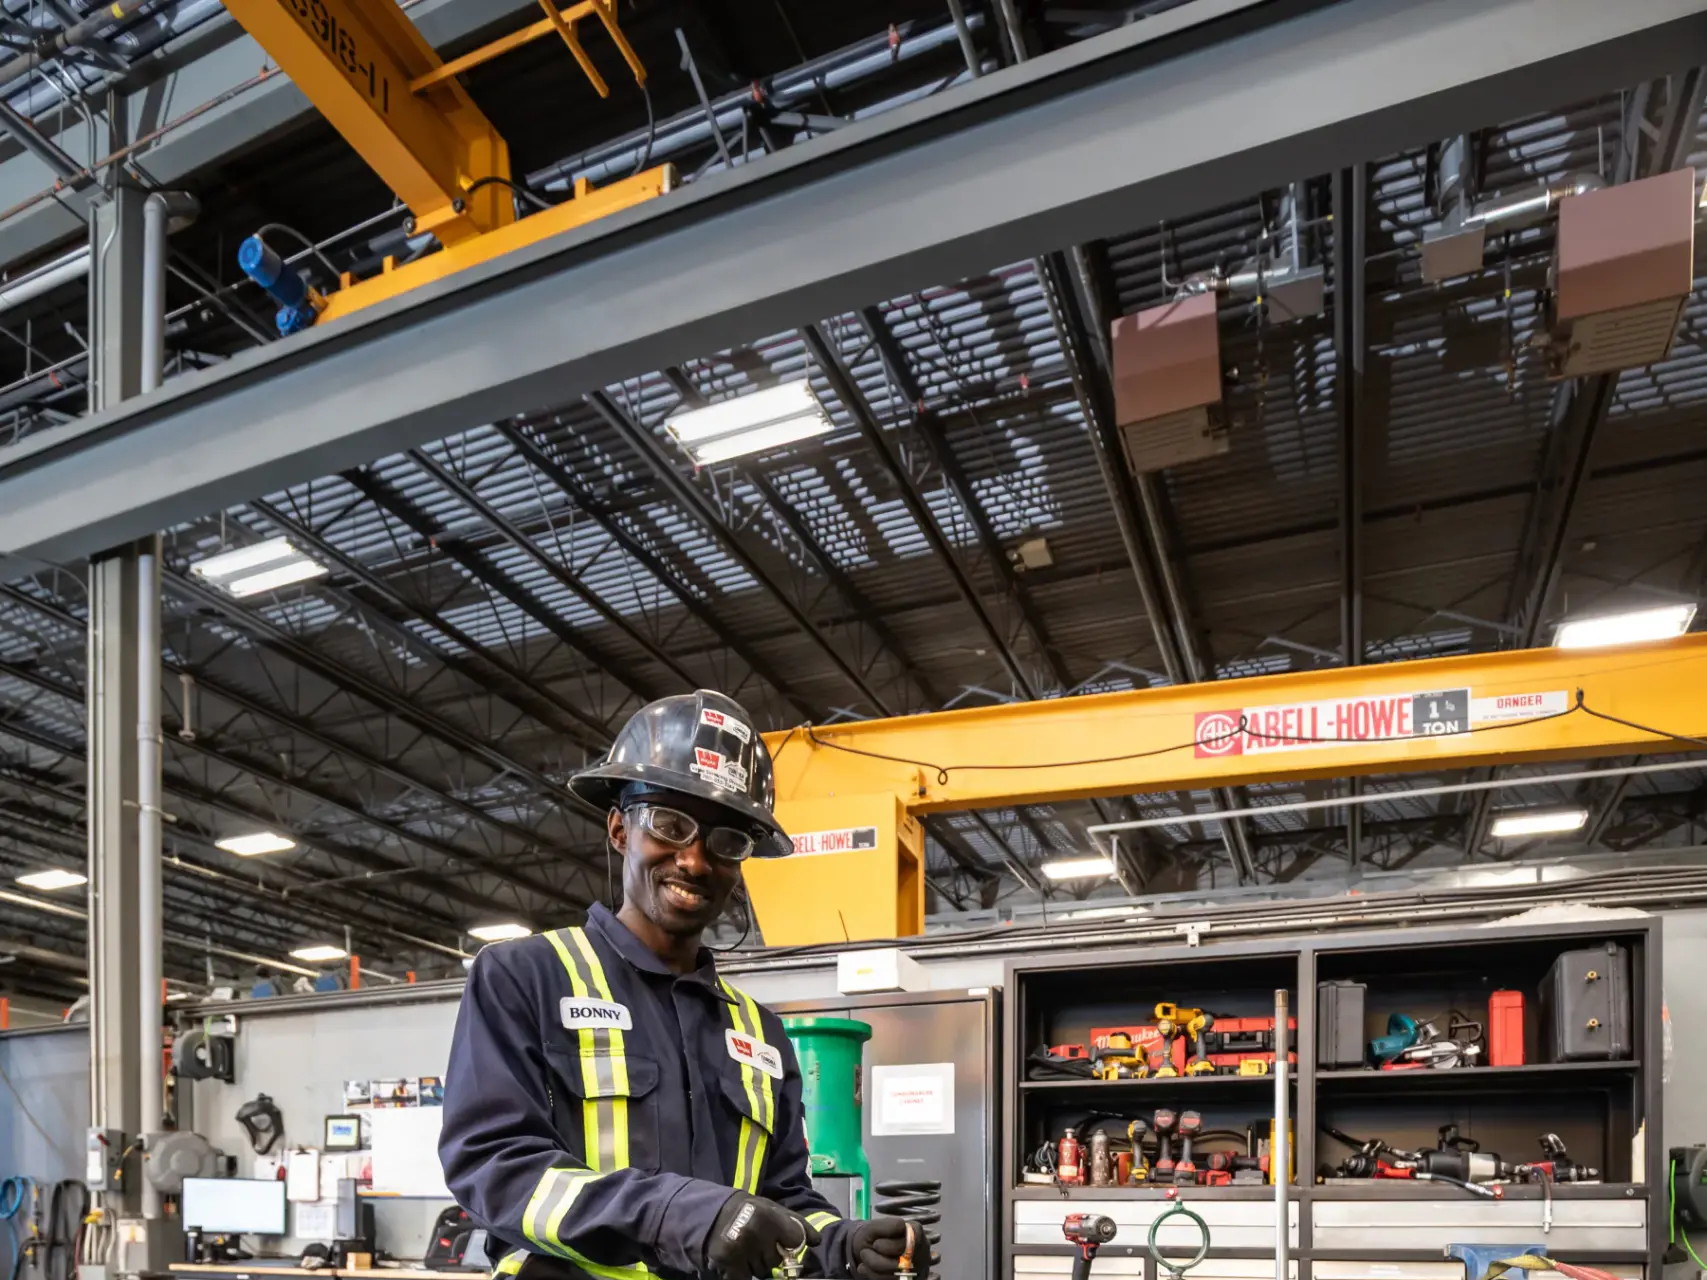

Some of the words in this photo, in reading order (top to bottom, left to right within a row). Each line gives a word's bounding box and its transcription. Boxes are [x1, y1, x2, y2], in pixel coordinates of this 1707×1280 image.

[1496, 695, 1542, 709] DANGER
[1246, 697, 1413, 750] ABELL-HOWE
[1422, 720, 1459, 735] TON
[569, 1007, 621, 1021] BONNY
